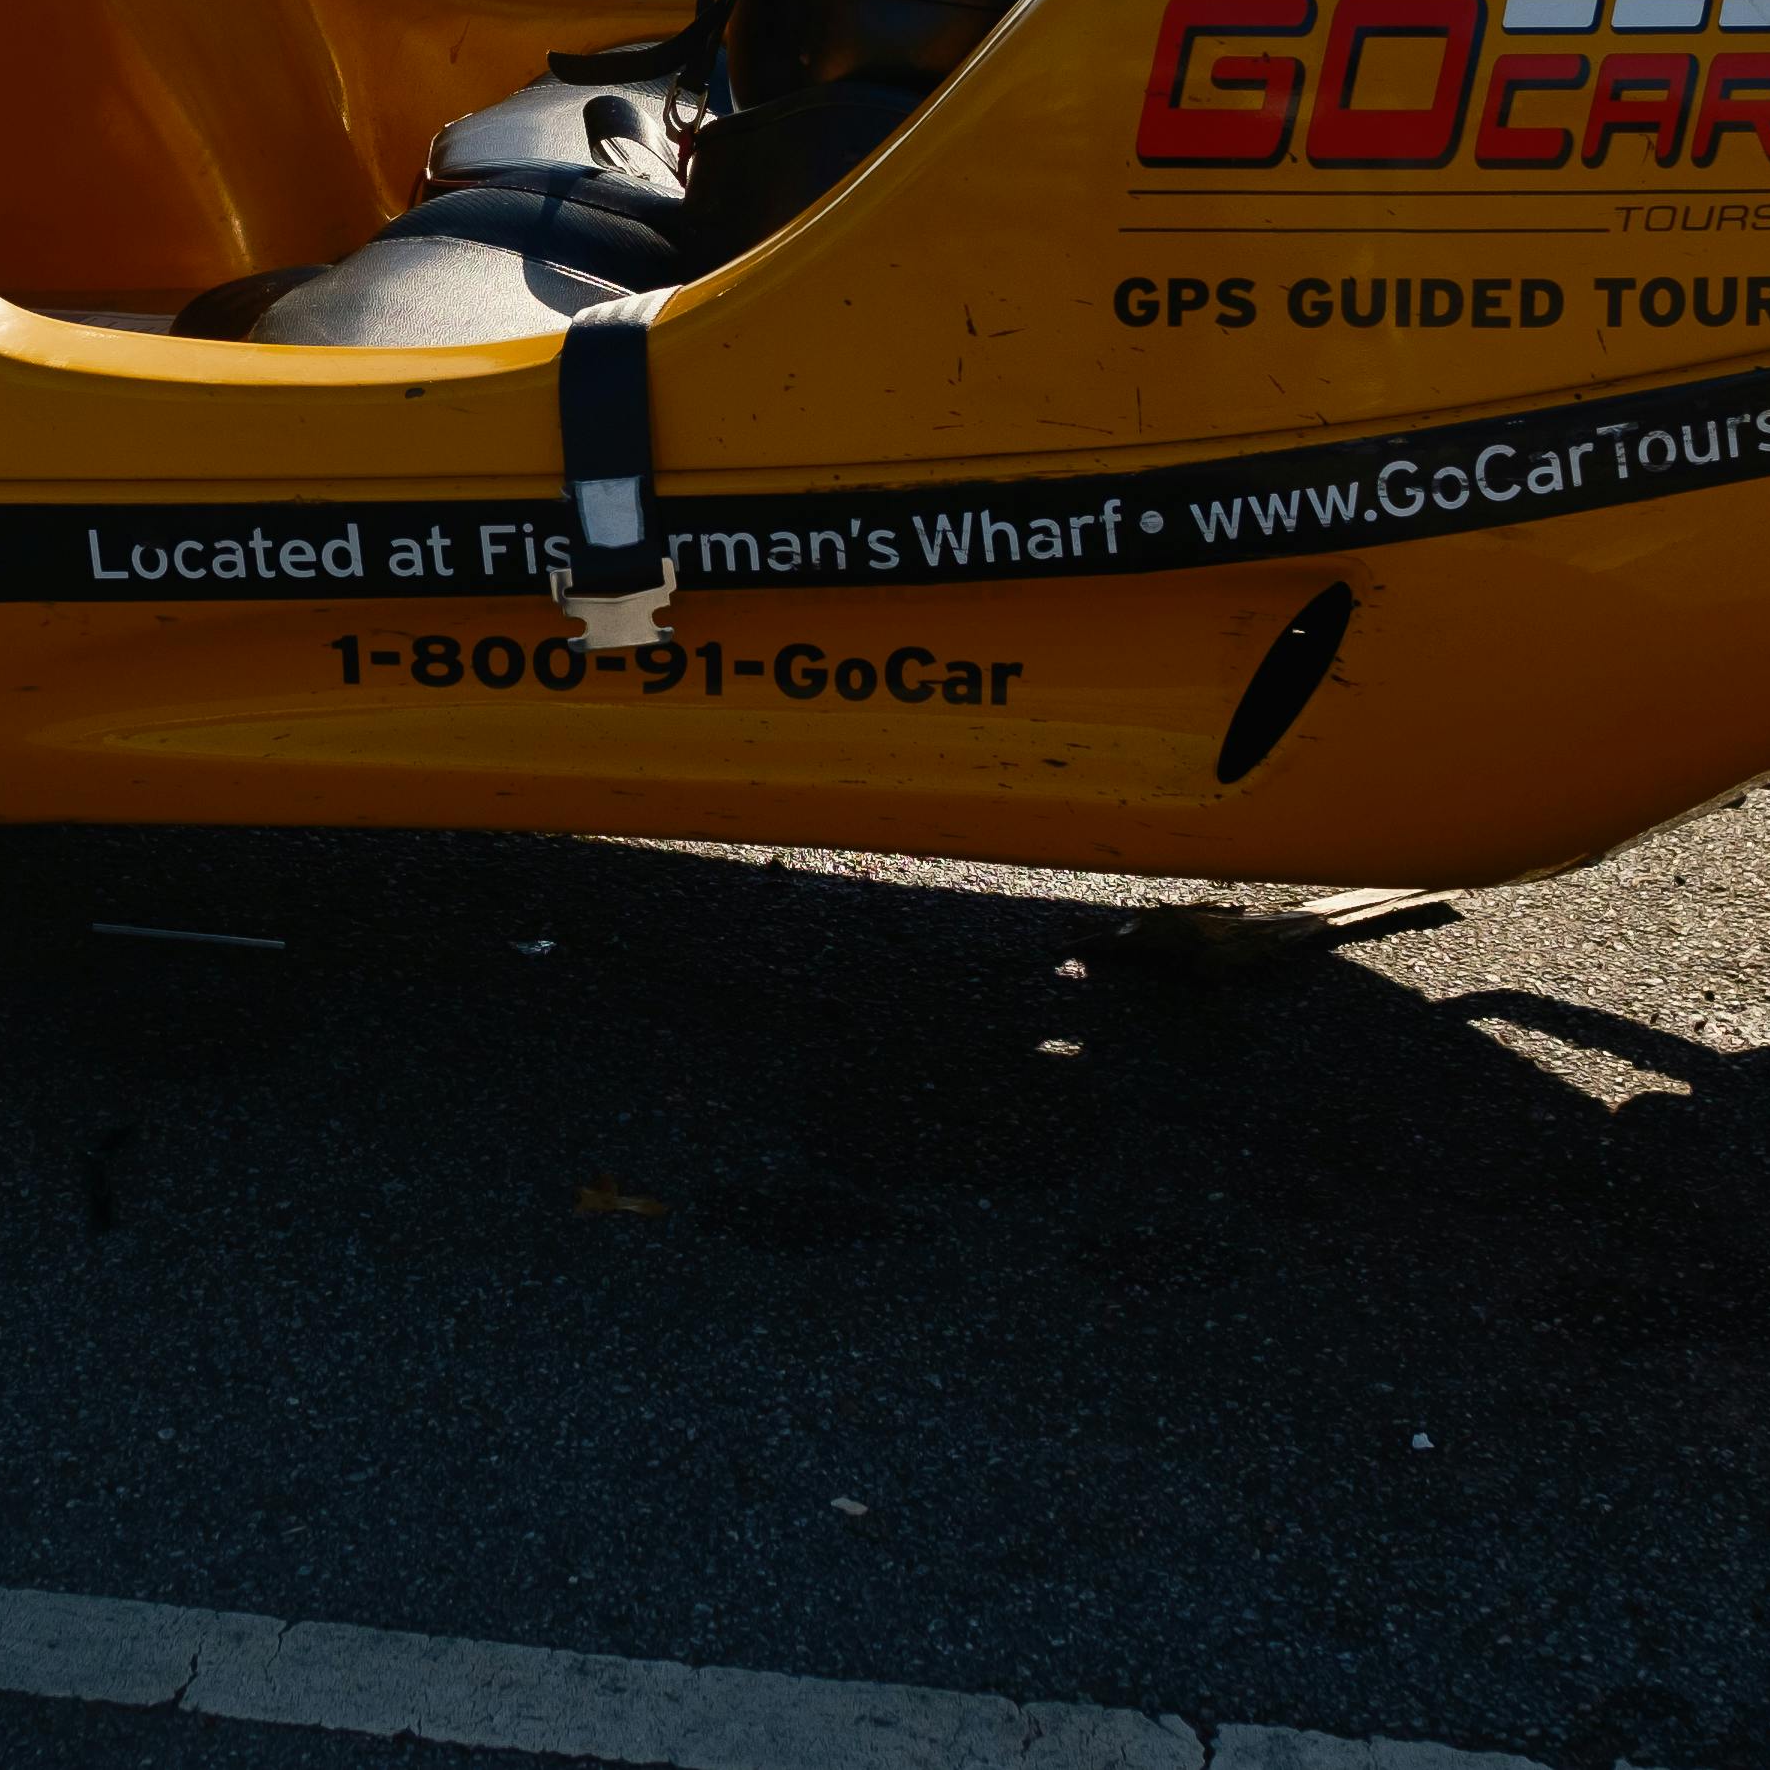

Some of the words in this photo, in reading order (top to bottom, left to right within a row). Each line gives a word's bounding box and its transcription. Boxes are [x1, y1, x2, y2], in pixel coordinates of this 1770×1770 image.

[1114, 277, 1258, 329] GPS
[1286, 276, 1564, 329] GUIDED
[89, 523, 364, 579] Located
[389, 525, 454, 577] at
[480, 518, 900, 576] Fisrman's
[913, 498, 1122, 566] Wharf
[331, 634, 1023, 706] 1-800-91-GoCar
